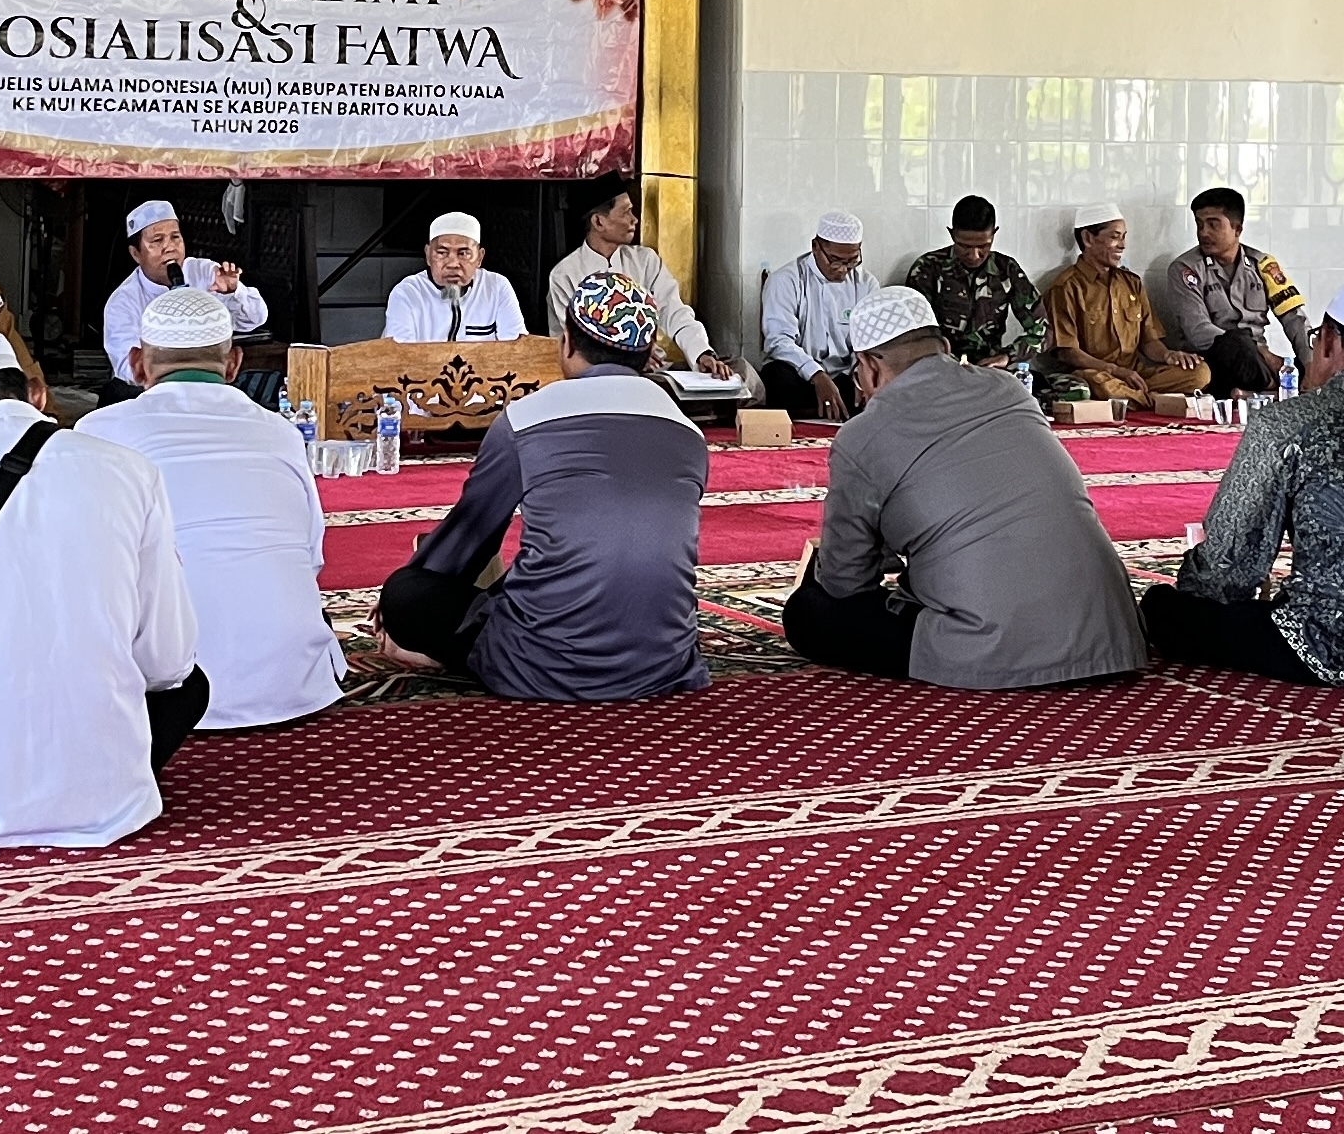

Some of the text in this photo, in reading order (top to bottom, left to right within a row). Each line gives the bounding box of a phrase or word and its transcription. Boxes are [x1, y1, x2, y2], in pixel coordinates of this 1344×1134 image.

[336, 25, 523, 79] FATWA
[48, 77, 114, 93] ULAMA
[119, 78, 218, 95] INDONESIA
[224, 77, 272, 99] (MUI)
[277, 81, 380, 97] KABUPATEN
[384, 83, 446, 98] BARITO
[450, 84, 505, 99] KUALA
[12, 96, 459, 117] KE MUI KECAMATAN SE KABUPATEN BARITO KUALA
[191, 119, 299, 134] TAHUN 2026
